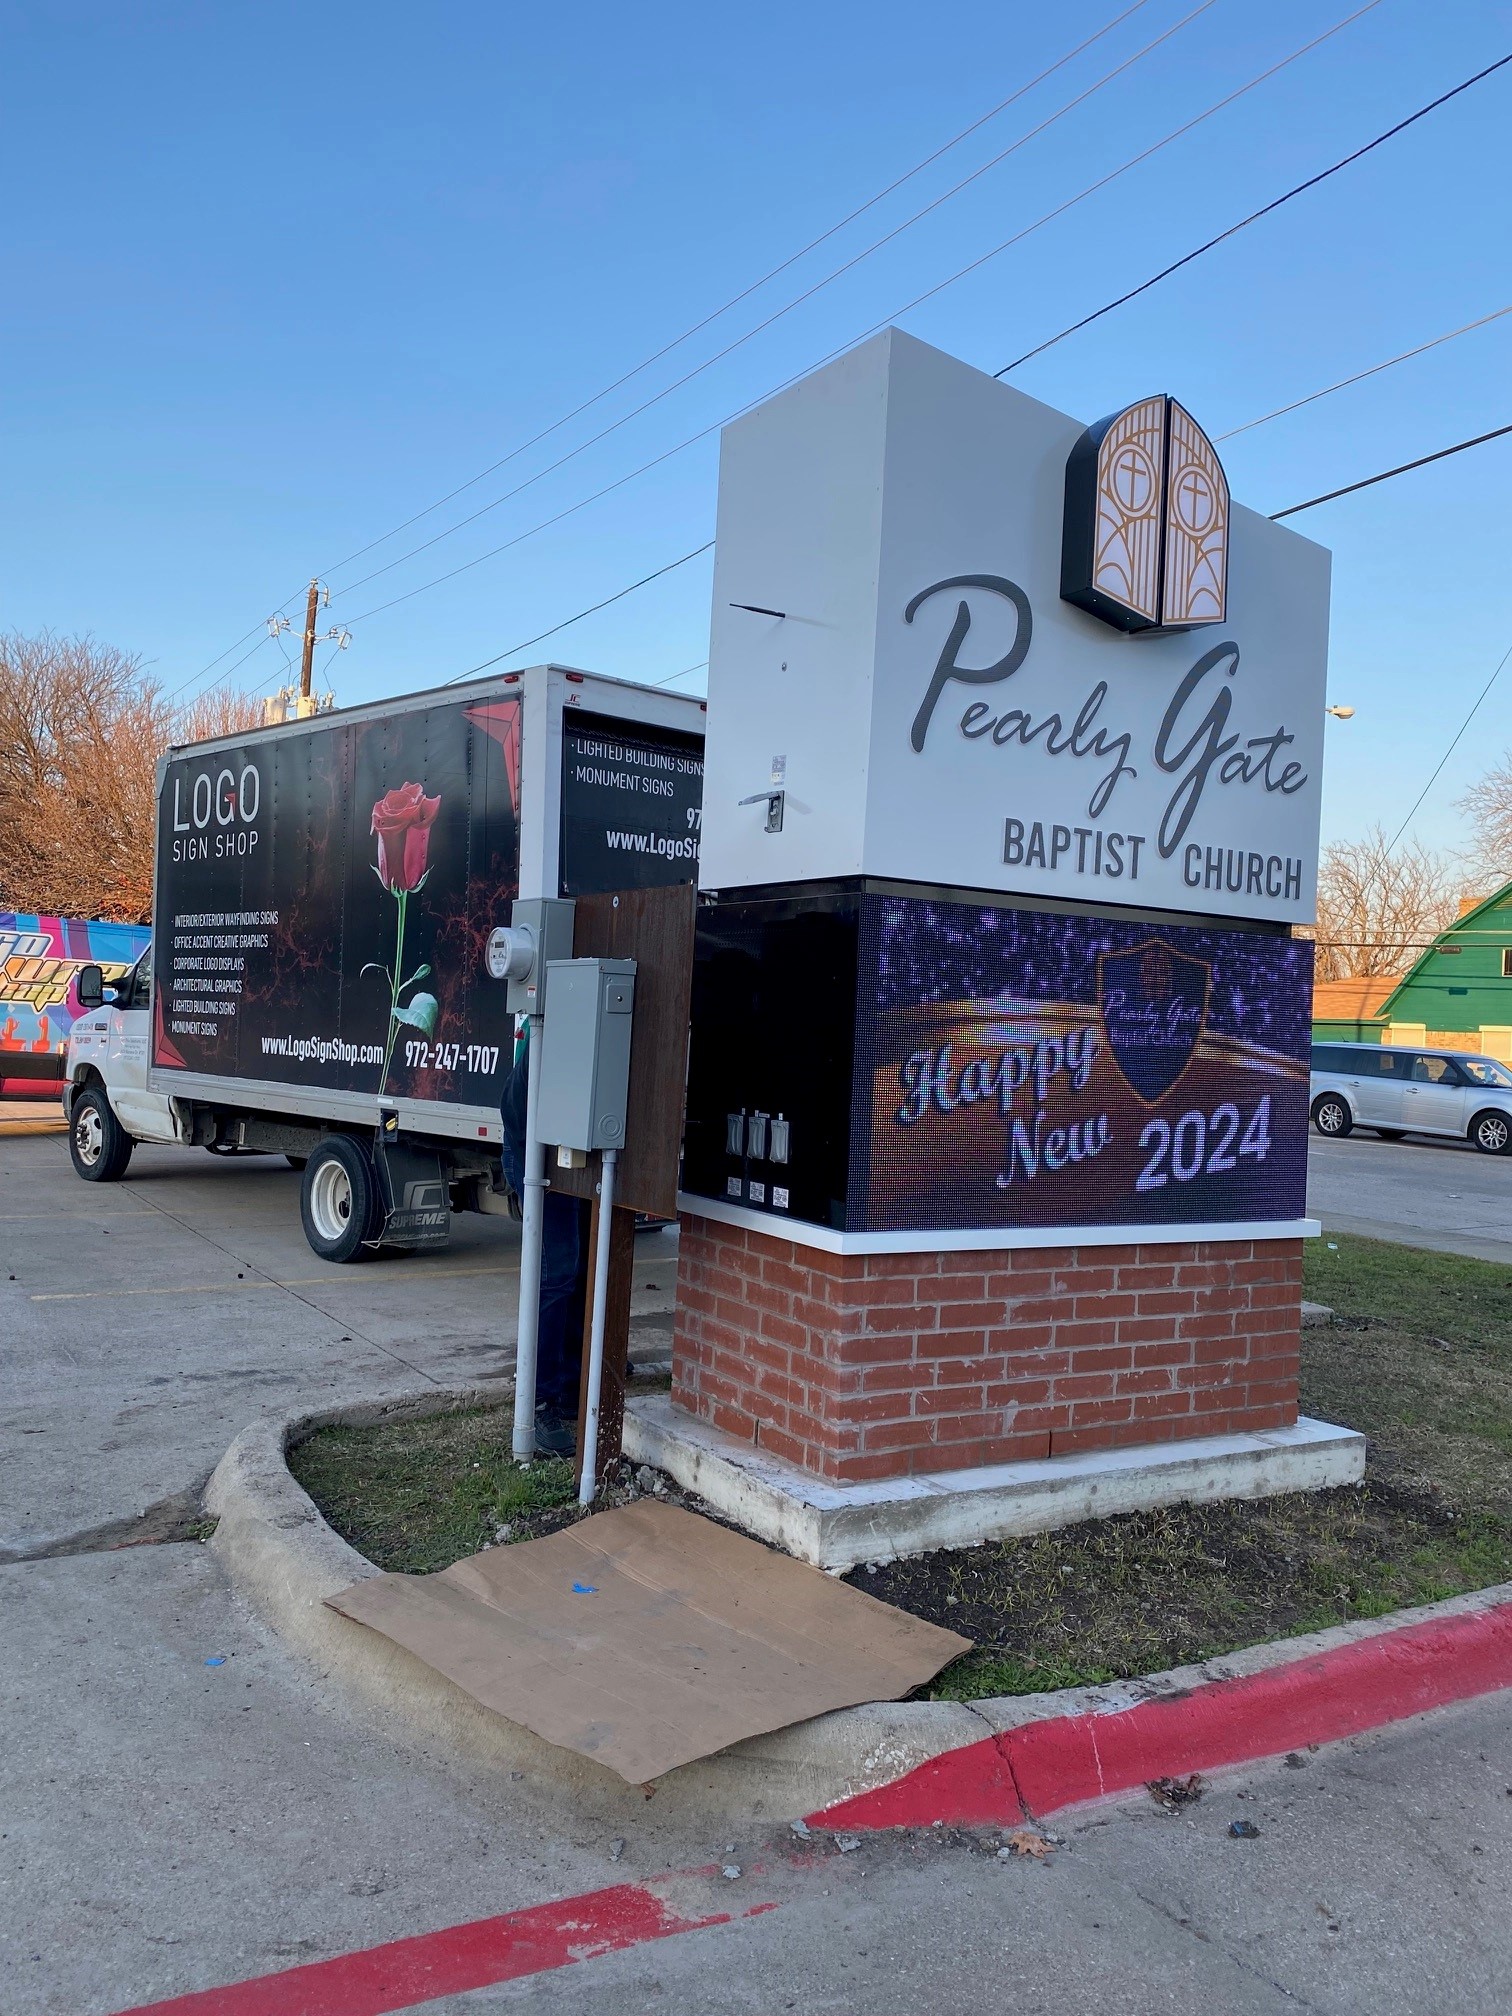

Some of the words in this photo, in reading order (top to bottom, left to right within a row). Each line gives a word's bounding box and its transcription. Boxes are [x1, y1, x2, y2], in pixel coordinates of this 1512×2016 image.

[904, 573, 1137, 818] Pearly
[1154, 640, 1308, 859] Gate
[577, 738, 623, 761] LIGHTED
[625, 748, 675, 771] BUILDING
[576, 765, 641, 791] MONUMENT
[642, 777, 674, 797] SIGNS
[173, 764, 260, 832] LOGO
[172, 836, 208, 862] SIGN
[215, 830, 259, 858] SHOP
[1003, 817, 1146, 879] BAPTIST
[1183, 843, 1302, 900] CHURCH
[225, 911, 260, 926] WAYFINDING
[260, 910, 279, 925] SIGNS
[174, 935, 193, 949] OFFICE
[193, 935, 214, 949] ACCENT
[214, 934, 239, 949] CREATIVE
[240, 933, 269, 948] GRAPHICS
[173, 957, 204, 970] CORPORATE
[203, 957, 219, 971] LOGO
[219, 957, 245, 971] DISPLAYS
[173, 978, 215, 992] ARCHITECTURAL
[214, 979, 243, 994] GRAPHICS
[172, 999, 194, 1013] LIGHTED
[193, 1000, 219, 1014] BUILDING
[219, 1001, 236, 1016] SIGNS
[171, 1020, 201, 1035] MONUMENT
[200, 1022, 218, 1037] SIGNS
[261, 1034, 384, 1067] www.LogoSignShop.com
[405, 1040, 499, 1075] 972-247-1707
[895, 1026, 1102, 1125] Happy
[996, 1111, 1113, 1188] New
[1135, 1094, 1272, 1192] 2024
[388, 1212, 447, 1230] SUPREME
